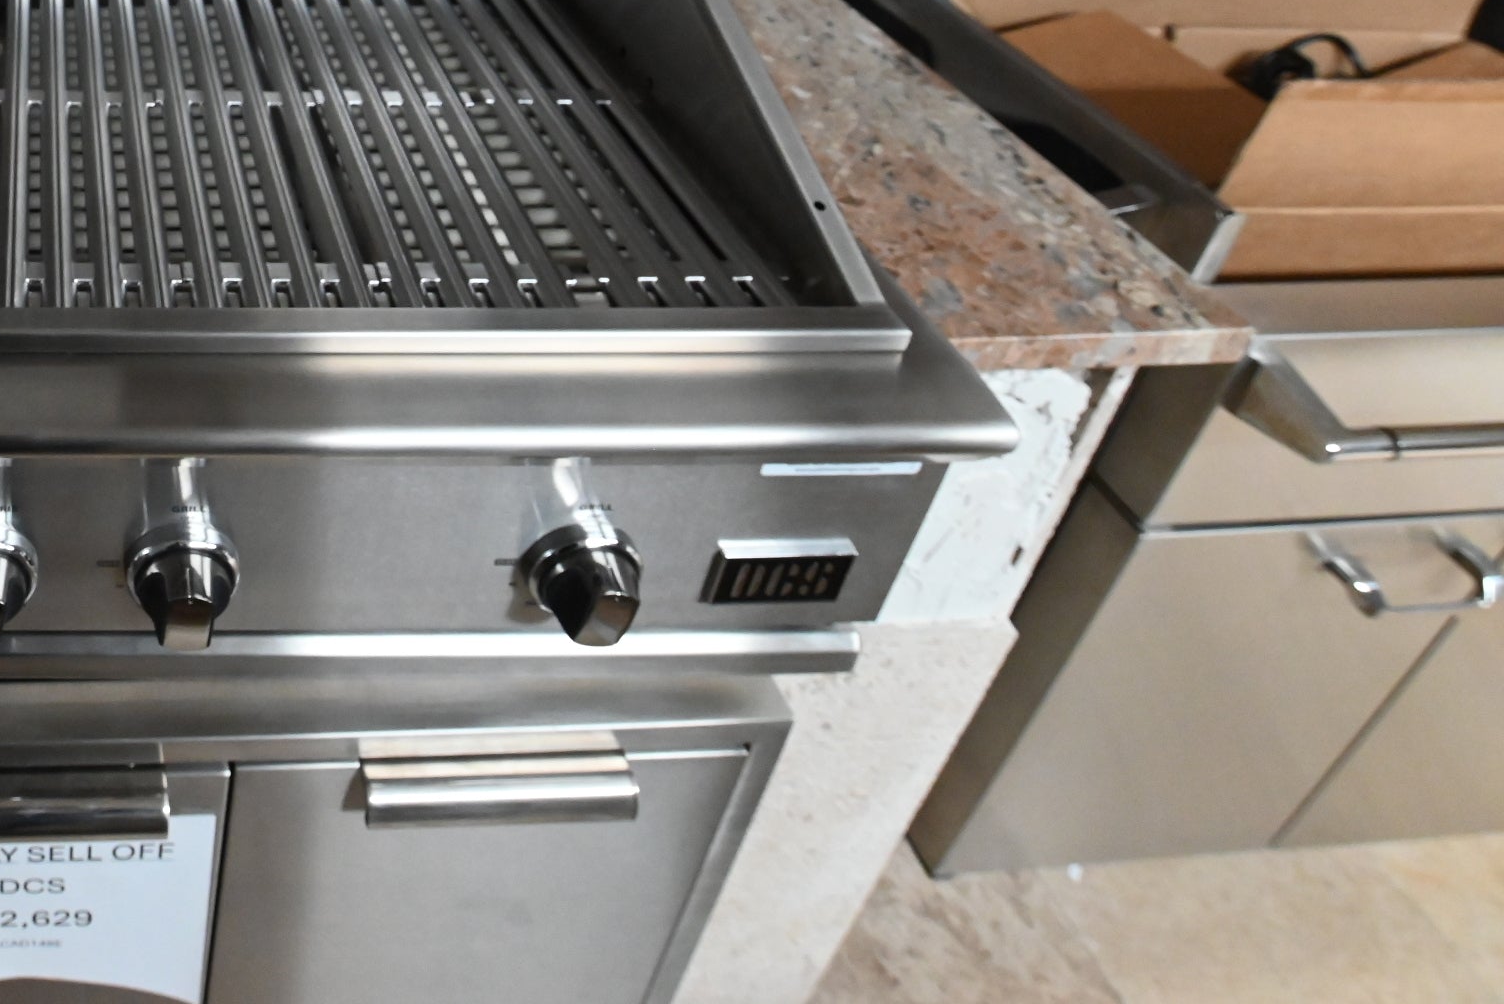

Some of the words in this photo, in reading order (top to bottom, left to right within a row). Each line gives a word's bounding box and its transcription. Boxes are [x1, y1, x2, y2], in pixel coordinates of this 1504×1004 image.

[729, 561, 835, 598] DCS
[27, 844, 102, 864] SELL
[112, 842, 174, 862] OFF
[0, 878, 66, 895] DCS
